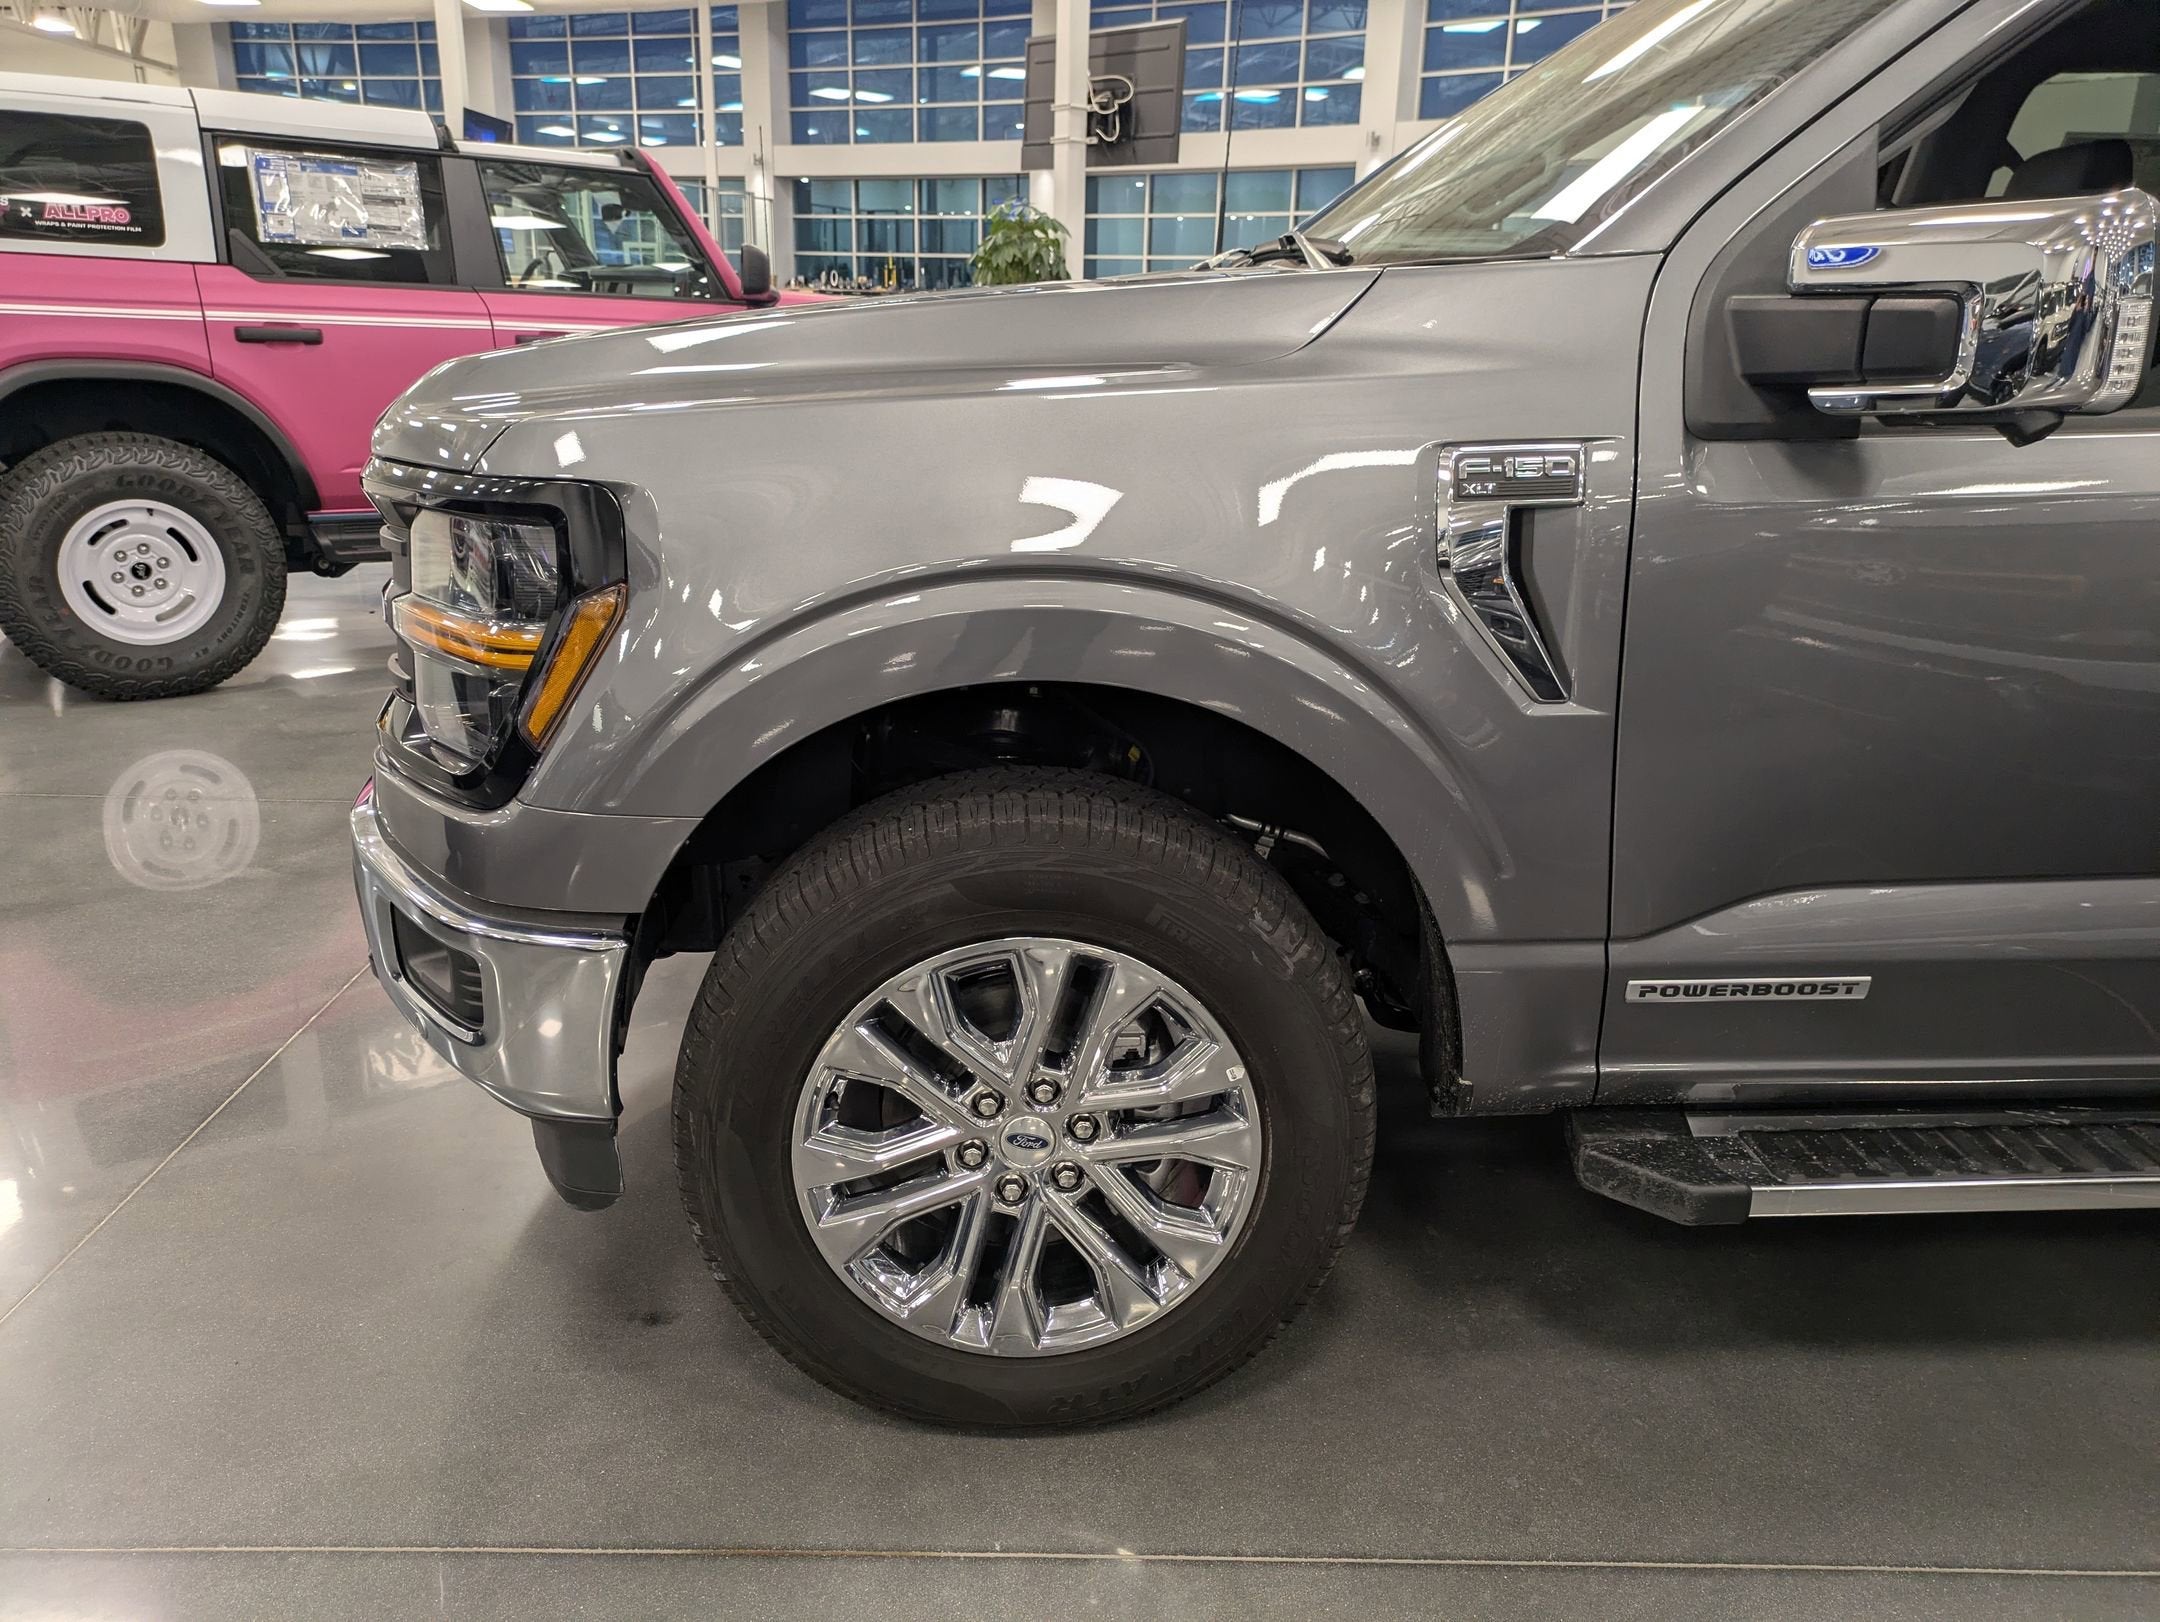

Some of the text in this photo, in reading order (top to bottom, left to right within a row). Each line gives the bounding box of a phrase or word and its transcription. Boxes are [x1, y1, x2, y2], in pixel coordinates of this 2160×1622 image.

[44, 202, 131, 224] ALLPRO
[34, 220, 60, 228] WRAPS
[87, 223, 126, 232] PROTECTION
[126, 225, 142, 233] FILM
[1458, 456, 1576, 480] F-150
[1462, 482, 1497, 495] XLT
[1638, 981, 1861, 998] POWERBOOST
[1013, 1135, 1043, 1148] Ford
